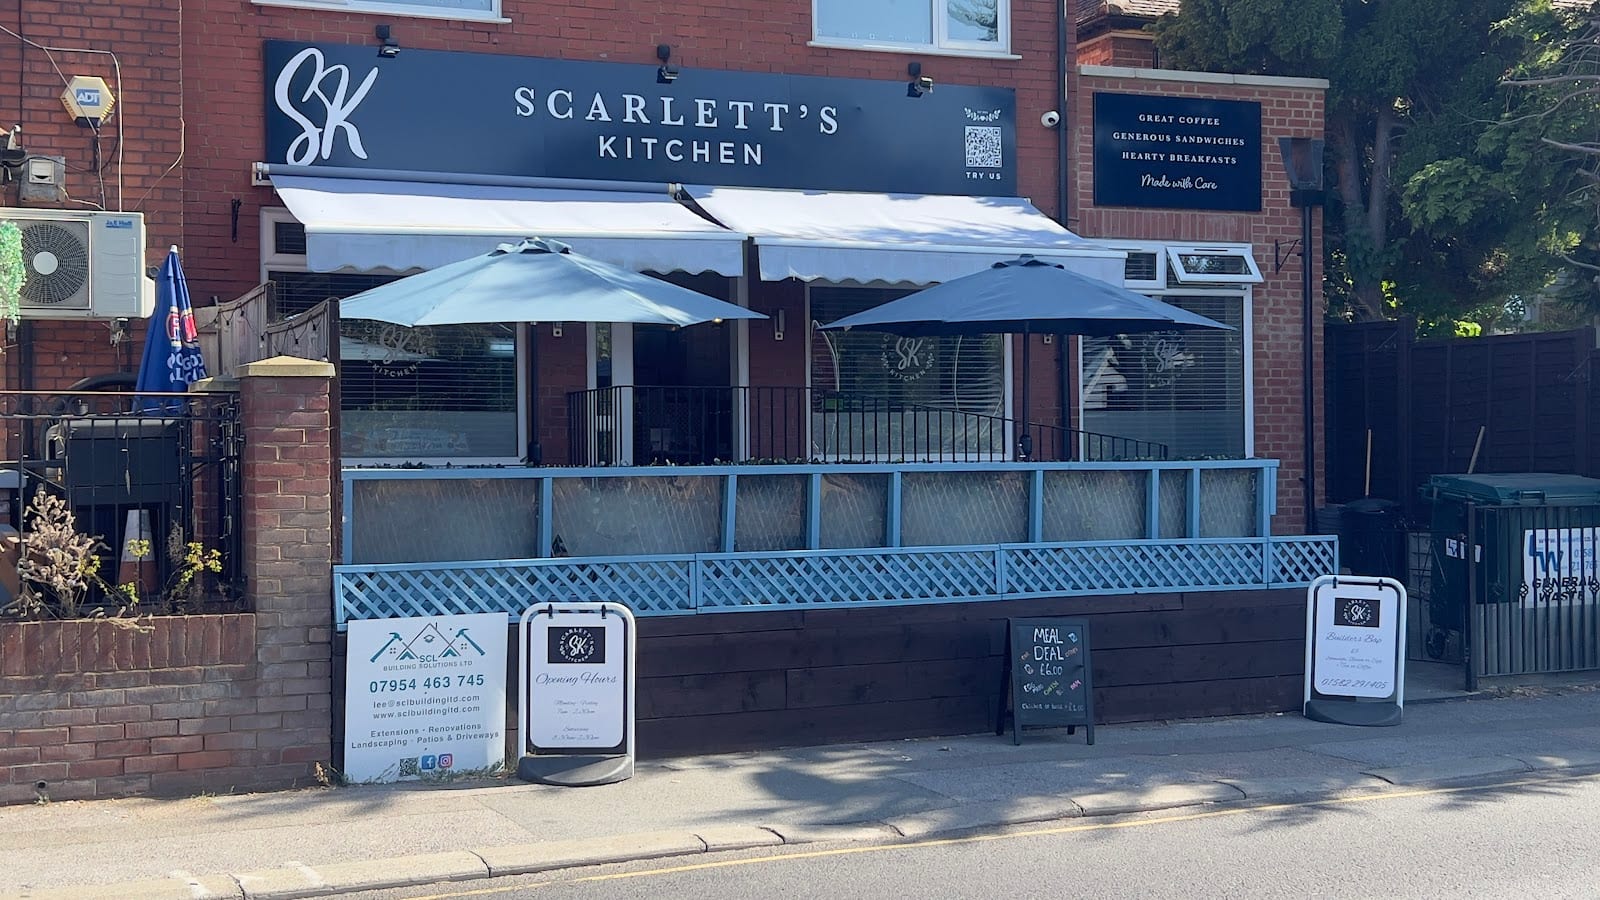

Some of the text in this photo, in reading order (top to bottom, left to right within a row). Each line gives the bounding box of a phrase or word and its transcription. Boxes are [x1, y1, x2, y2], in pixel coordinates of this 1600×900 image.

[77, 92, 100, 103] ADT
[274, 47, 379, 167] SK
[514, 86, 839, 135] SCARLETT'S
[1138, 114, 1220, 126] GREAT COFFEE
[1113, 132, 1245, 146] GENEROUS SANDWICHES
[598, 136, 763, 166] KITCHEN
[1122, 152, 1237, 165] HEARTY BREAKFASTS
[1141, 174, 1218, 190] Made with Care
[372, 363, 417, 378] KITCHEN
[1033, 628, 1064, 644] MEAL
[569, 635, 588, 656] SK
[1033, 645, 1065, 661] DEAL
[419, 654, 438, 662] SCL
[370, 674, 485, 693] 07954 463 745
[536, 671, 617, 686] Opening Hours
[373, 695, 480, 708] lee@sclbuildingltd.com
[373, 705, 480, 719] www.sclbuildingltd.com
[371, 723, 481, 738] Extensions Renovations
[351, 738, 408, 749] Landscaping
[417, 735, 444, 744] Patios
[456, 731, 499, 741] Driveways
